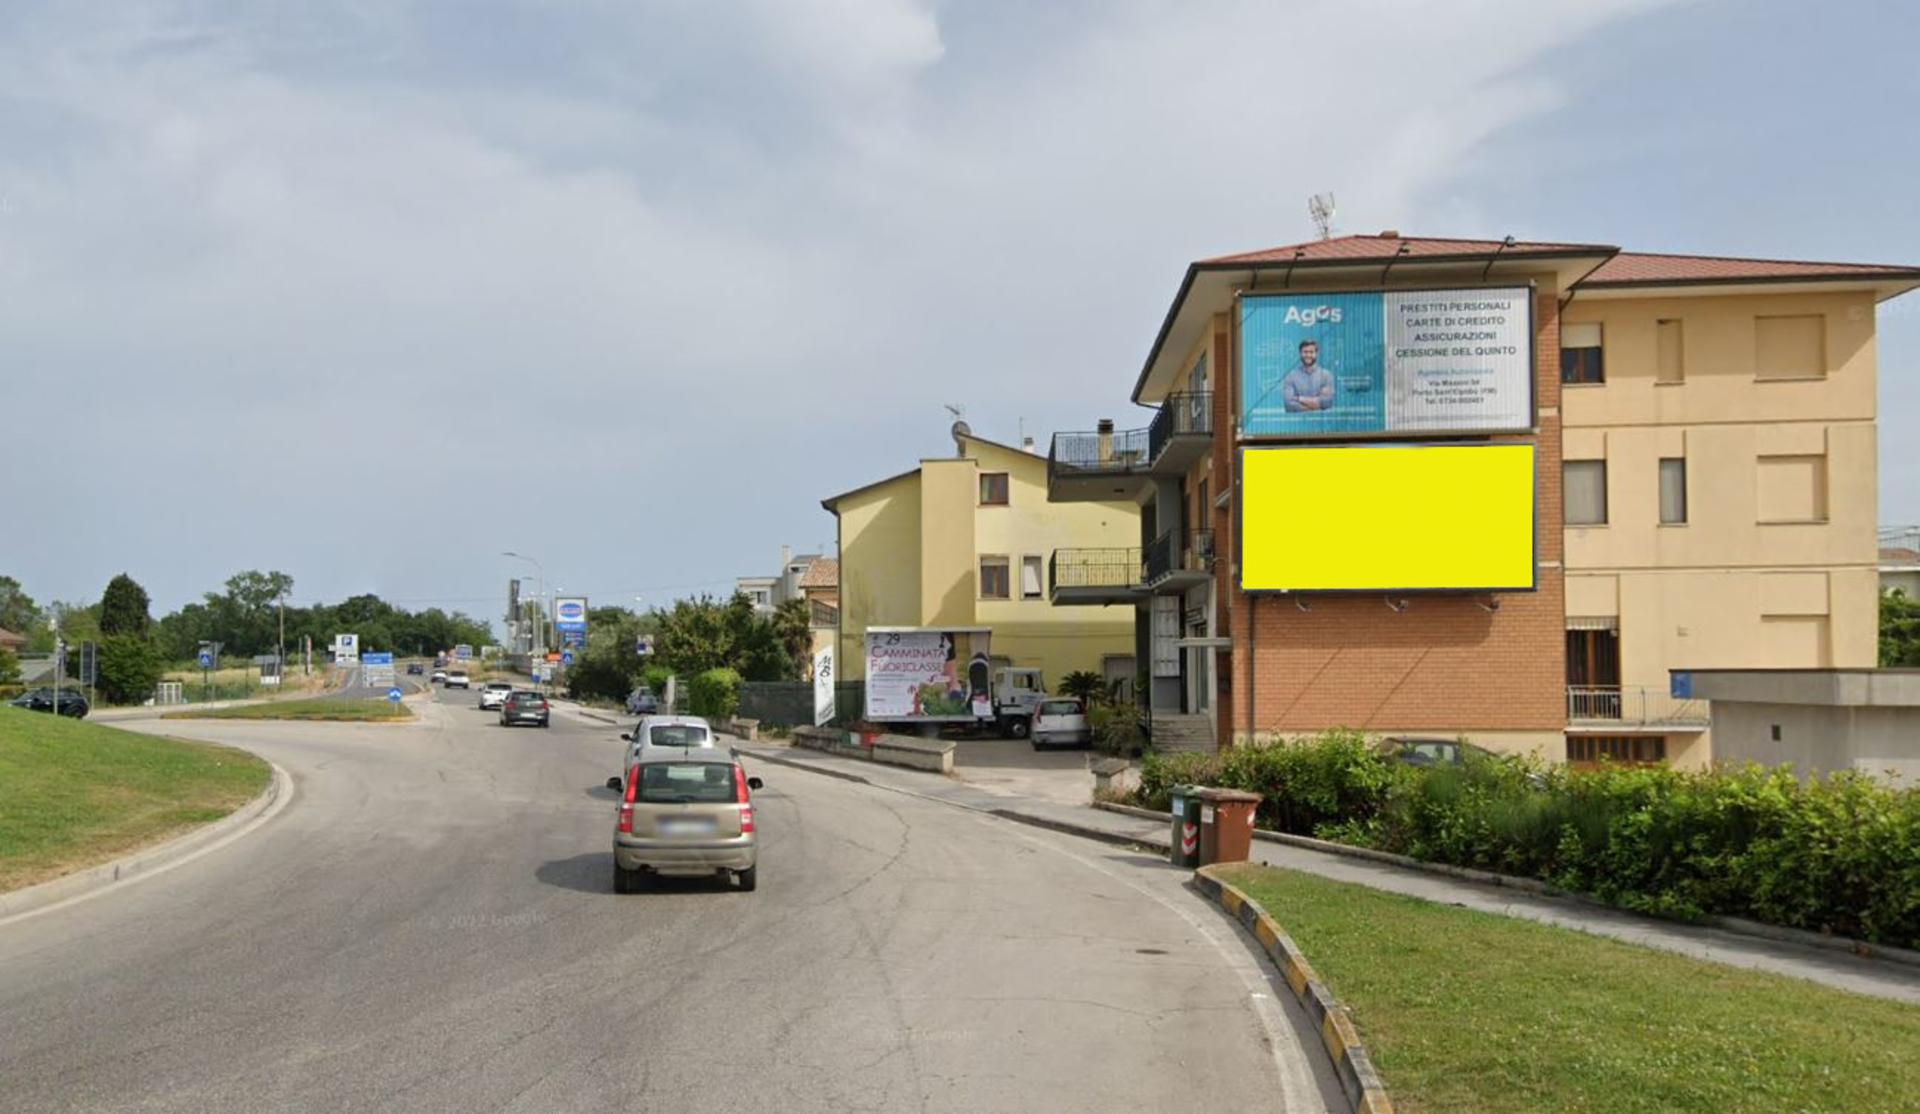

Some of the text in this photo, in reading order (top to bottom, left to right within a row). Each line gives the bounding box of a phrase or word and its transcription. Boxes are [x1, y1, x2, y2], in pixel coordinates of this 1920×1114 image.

[1400, 301, 1511, 312] PRESTITI PERSONALI
[1284, 305, 1342, 327] Agos
[1406, 316, 1505, 327] CARTE DI CREDITO
[1414, 331, 1497, 341] ASSICURAZIONI
[1396, 346, 1516, 358] CESSIONE DEL QUINTO
[886, 633, 900, 645] 29
